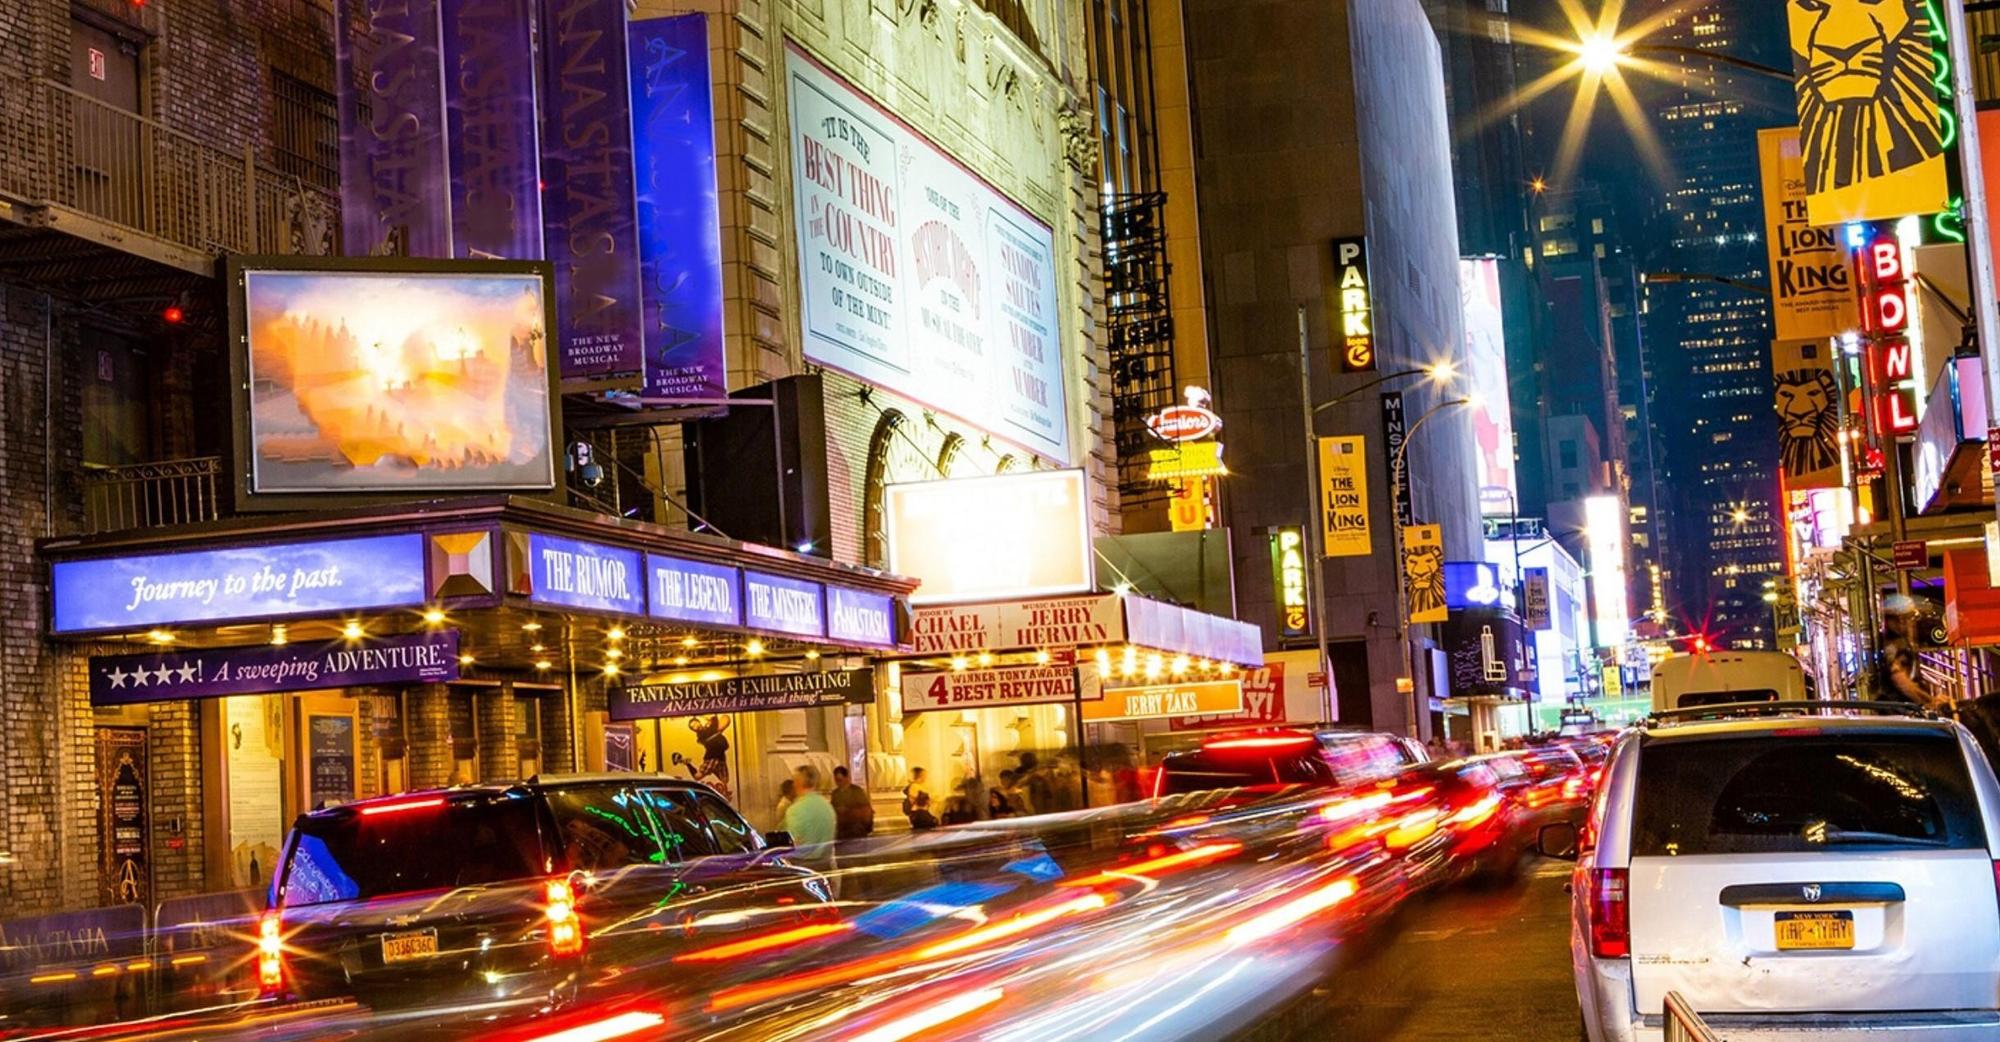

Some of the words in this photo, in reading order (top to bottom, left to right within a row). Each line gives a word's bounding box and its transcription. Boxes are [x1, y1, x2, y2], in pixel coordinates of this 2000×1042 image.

[850, 125, 870, 164] THE
[803, 133, 844, 198] BEST
[847, 162, 895, 228] THING
[1782, 200, 1808, 219] TH
[825, 202, 896, 279] COUNTRY
[1778, 224, 1836, 257] LION
[820, 251, 833, 274] TO
[835, 260, 855, 286] OWN
[857, 271, 893, 304] OUTSIDE
[1776, 259, 1848, 298] KING
[1340, 243, 1371, 337] PARK
[832, 287, 844, 308] OF
[846, 293, 865, 318] THE
[568, 344, 624, 356] BROADWAY
[572, 337, 592, 346] THE
[596, 334, 620, 344] NEW
[574, 355, 620, 365] MUSICAL
[659, 368, 679, 377] THE
[682, 365, 705, 375] NEW
[656, 375, 709, 387] BROADWAY
[661, 384, 705, 395] MUSICAL
[1331, 477, 1353, 489] THE
[1328, 491, 1359, 510] LION
[1328, 510, 1365, 533] KING
[543, 549, 573, 592] THE
[576, 553, 630, 600] RUMOR.
[1280, 531, 1306, 606] PARK
[126, 575, 218, 611] Journey
[224, 573, 245, 595] to
[251, 564, 288, 592] the
[291, 565, 344, 600] past.
[657, 567, 682, 607] THE
[684, 571, 732, 614] LEGEND.
[749, 582, 771, 619] THE
[1022, 602, 1049, 610] MUSIC
[914, 614, 985, 635] CHAEL
[919, 610, 942, 618] BOOK
[944, 609, 954, 617] BY
[1028, 607, 1092, 627] JERRY
[914, 631, 987, 652] EWART
[1017, 624, 1107, 646] HERMAN
[211, 660, 230, 682] A
[235, 656, 319, 684] sweeping
[951, 671, 996, 685] WINNER
[999, 668, 1027, 681] TONY
[1029, 666, 1075, 680] AWARDS
[727, 683, 738, 696] &
[742, 671, 851, 694] EXHILARATING!
[928, 675, 948, 705] 4
[952, 683, 996, 702] BEST
[999, 677, 1075, 699] REVIVAL
[662, 696, 738, 713] ANASTASIA
[739, 694, 747, 707] is
[749, 693, 765, 707] the
[766, 692, 787, 706] real
[1124, 695, 1163, 716] JERRY
[1165, 693, 1197, 714] ZAKS
